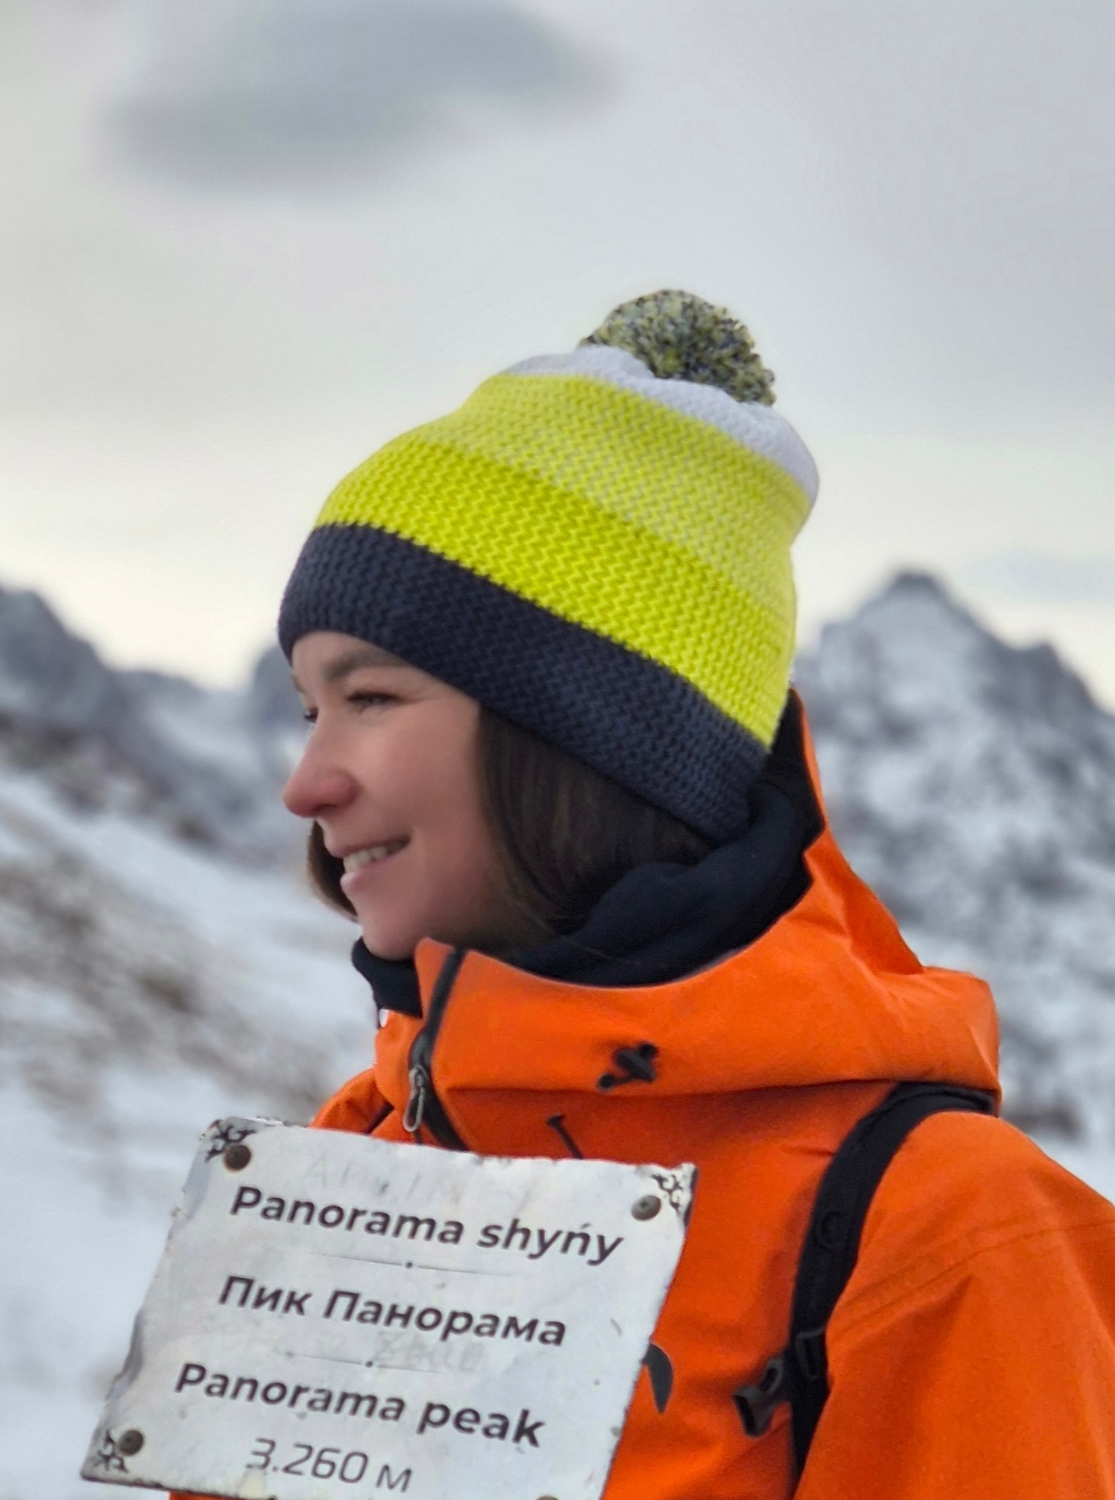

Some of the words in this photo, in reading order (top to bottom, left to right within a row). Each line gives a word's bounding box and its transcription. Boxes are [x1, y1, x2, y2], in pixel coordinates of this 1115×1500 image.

[229, 1184, 465, 1246] Panorama
[477, 1218, 624, 1267] shyńy
[218, 1275, 313, 1316] Пик
[323, 1289, 567, 1347] Панорама
[174, 1362, 406, 1422] Panorama
[416, 1402, 545, 1449] peak
[246, 1437, 369, 1484] 3.260
